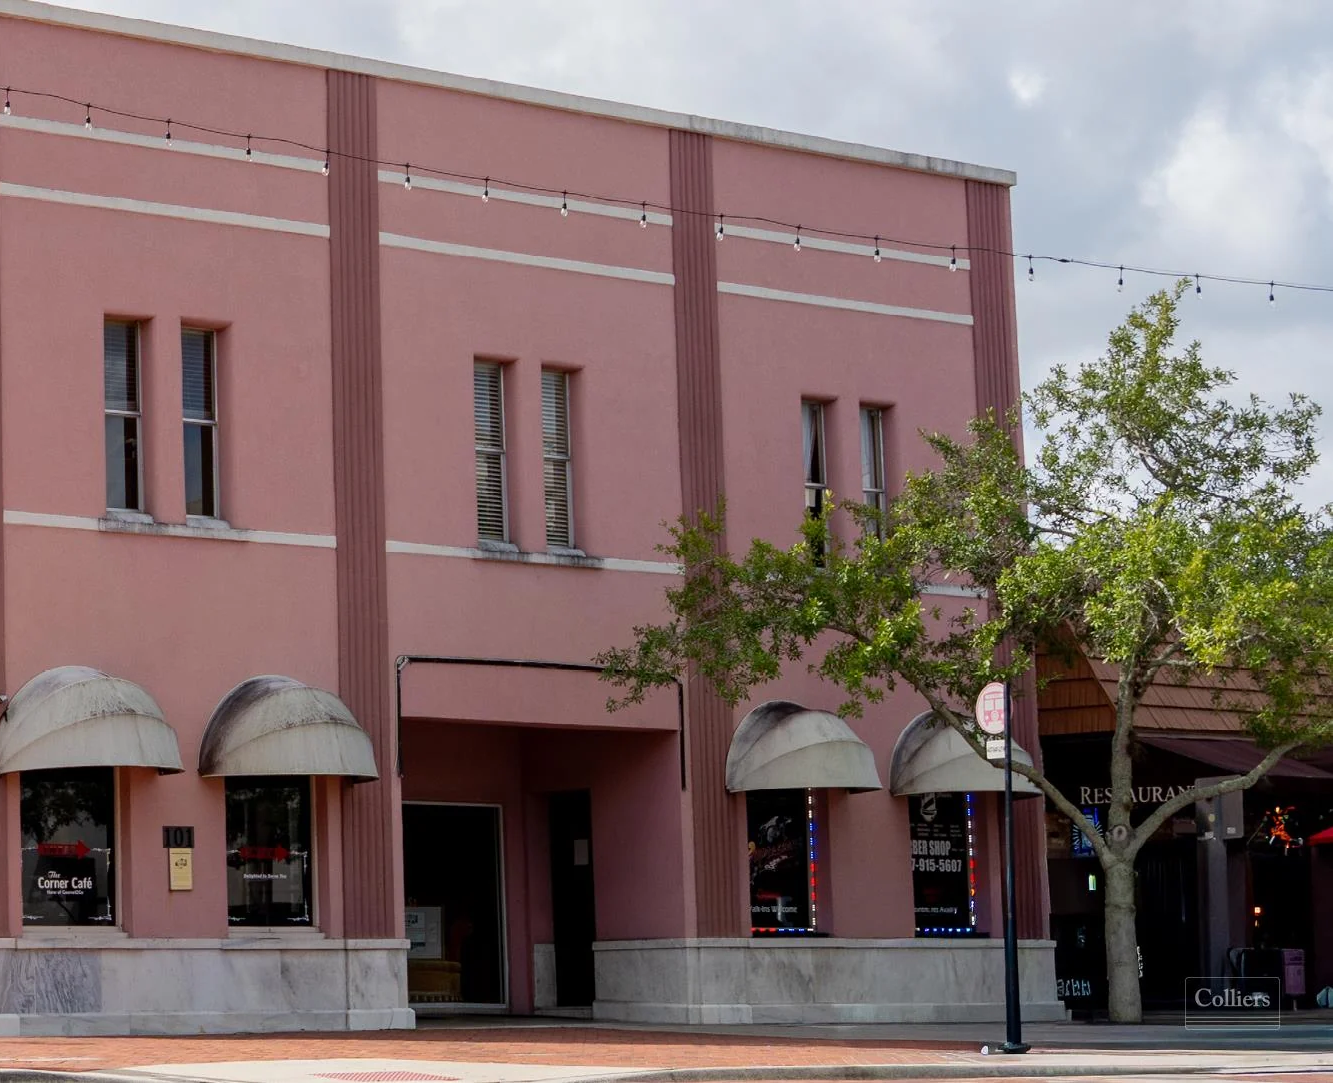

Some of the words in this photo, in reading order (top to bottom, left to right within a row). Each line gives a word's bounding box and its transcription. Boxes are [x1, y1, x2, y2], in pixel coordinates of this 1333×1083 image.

[1080, 785, 1195, 804] RESAURAN
[164, 827, 193, 847] 101
[910, 840, 928, 855] BER
[929, 840, 951, 856] SHOP
[910, 858, 962, 872] 7-915-5607
[48, 870, 61, 879] The
[38, 877, 69, 889] Corner
[71, 877, 92, 889] Café
